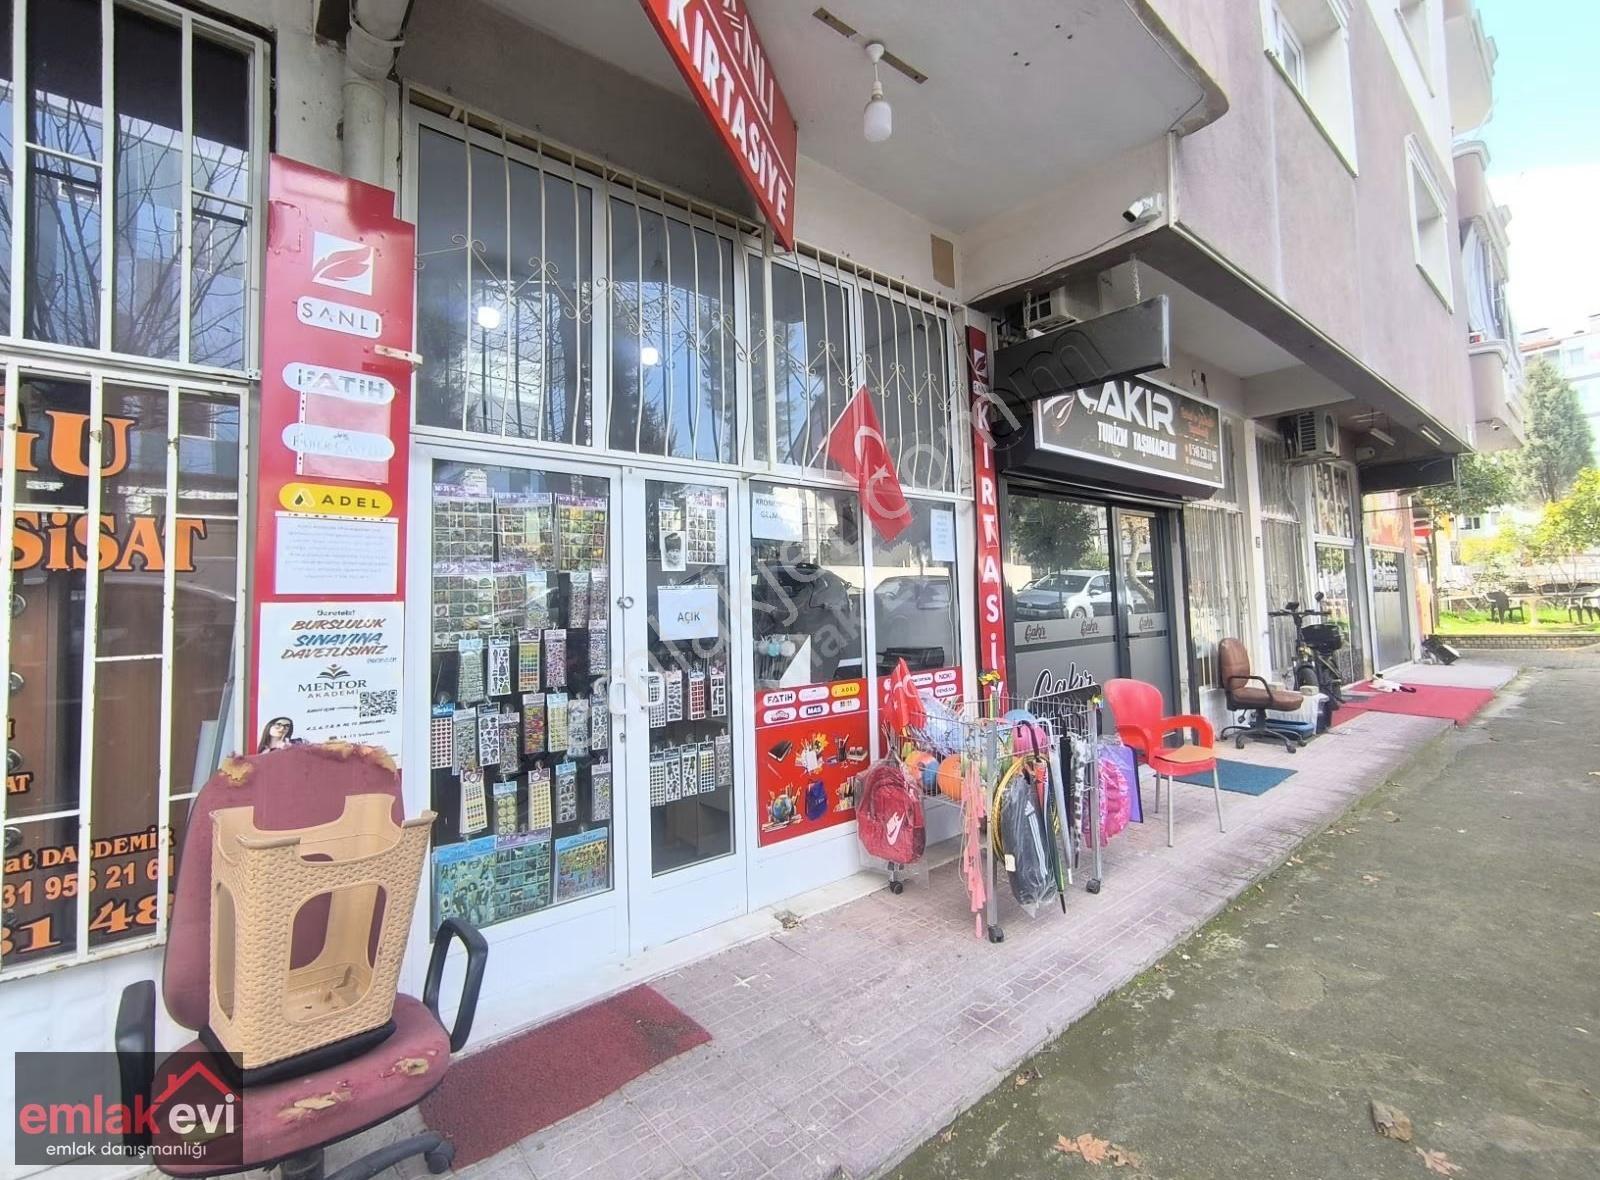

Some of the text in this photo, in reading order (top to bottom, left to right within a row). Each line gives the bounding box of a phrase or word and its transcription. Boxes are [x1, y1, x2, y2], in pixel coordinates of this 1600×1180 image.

[321, 494, 380, 509] ADEL
[291, 618, 387, 631] BURSLULUK
[677, 611, 701, 624] AÇIK
[293, 632, 383, 648] SINAVINA
[298, 679, 368, 693] MENTOR
[106, 862, 135, 889] 21
